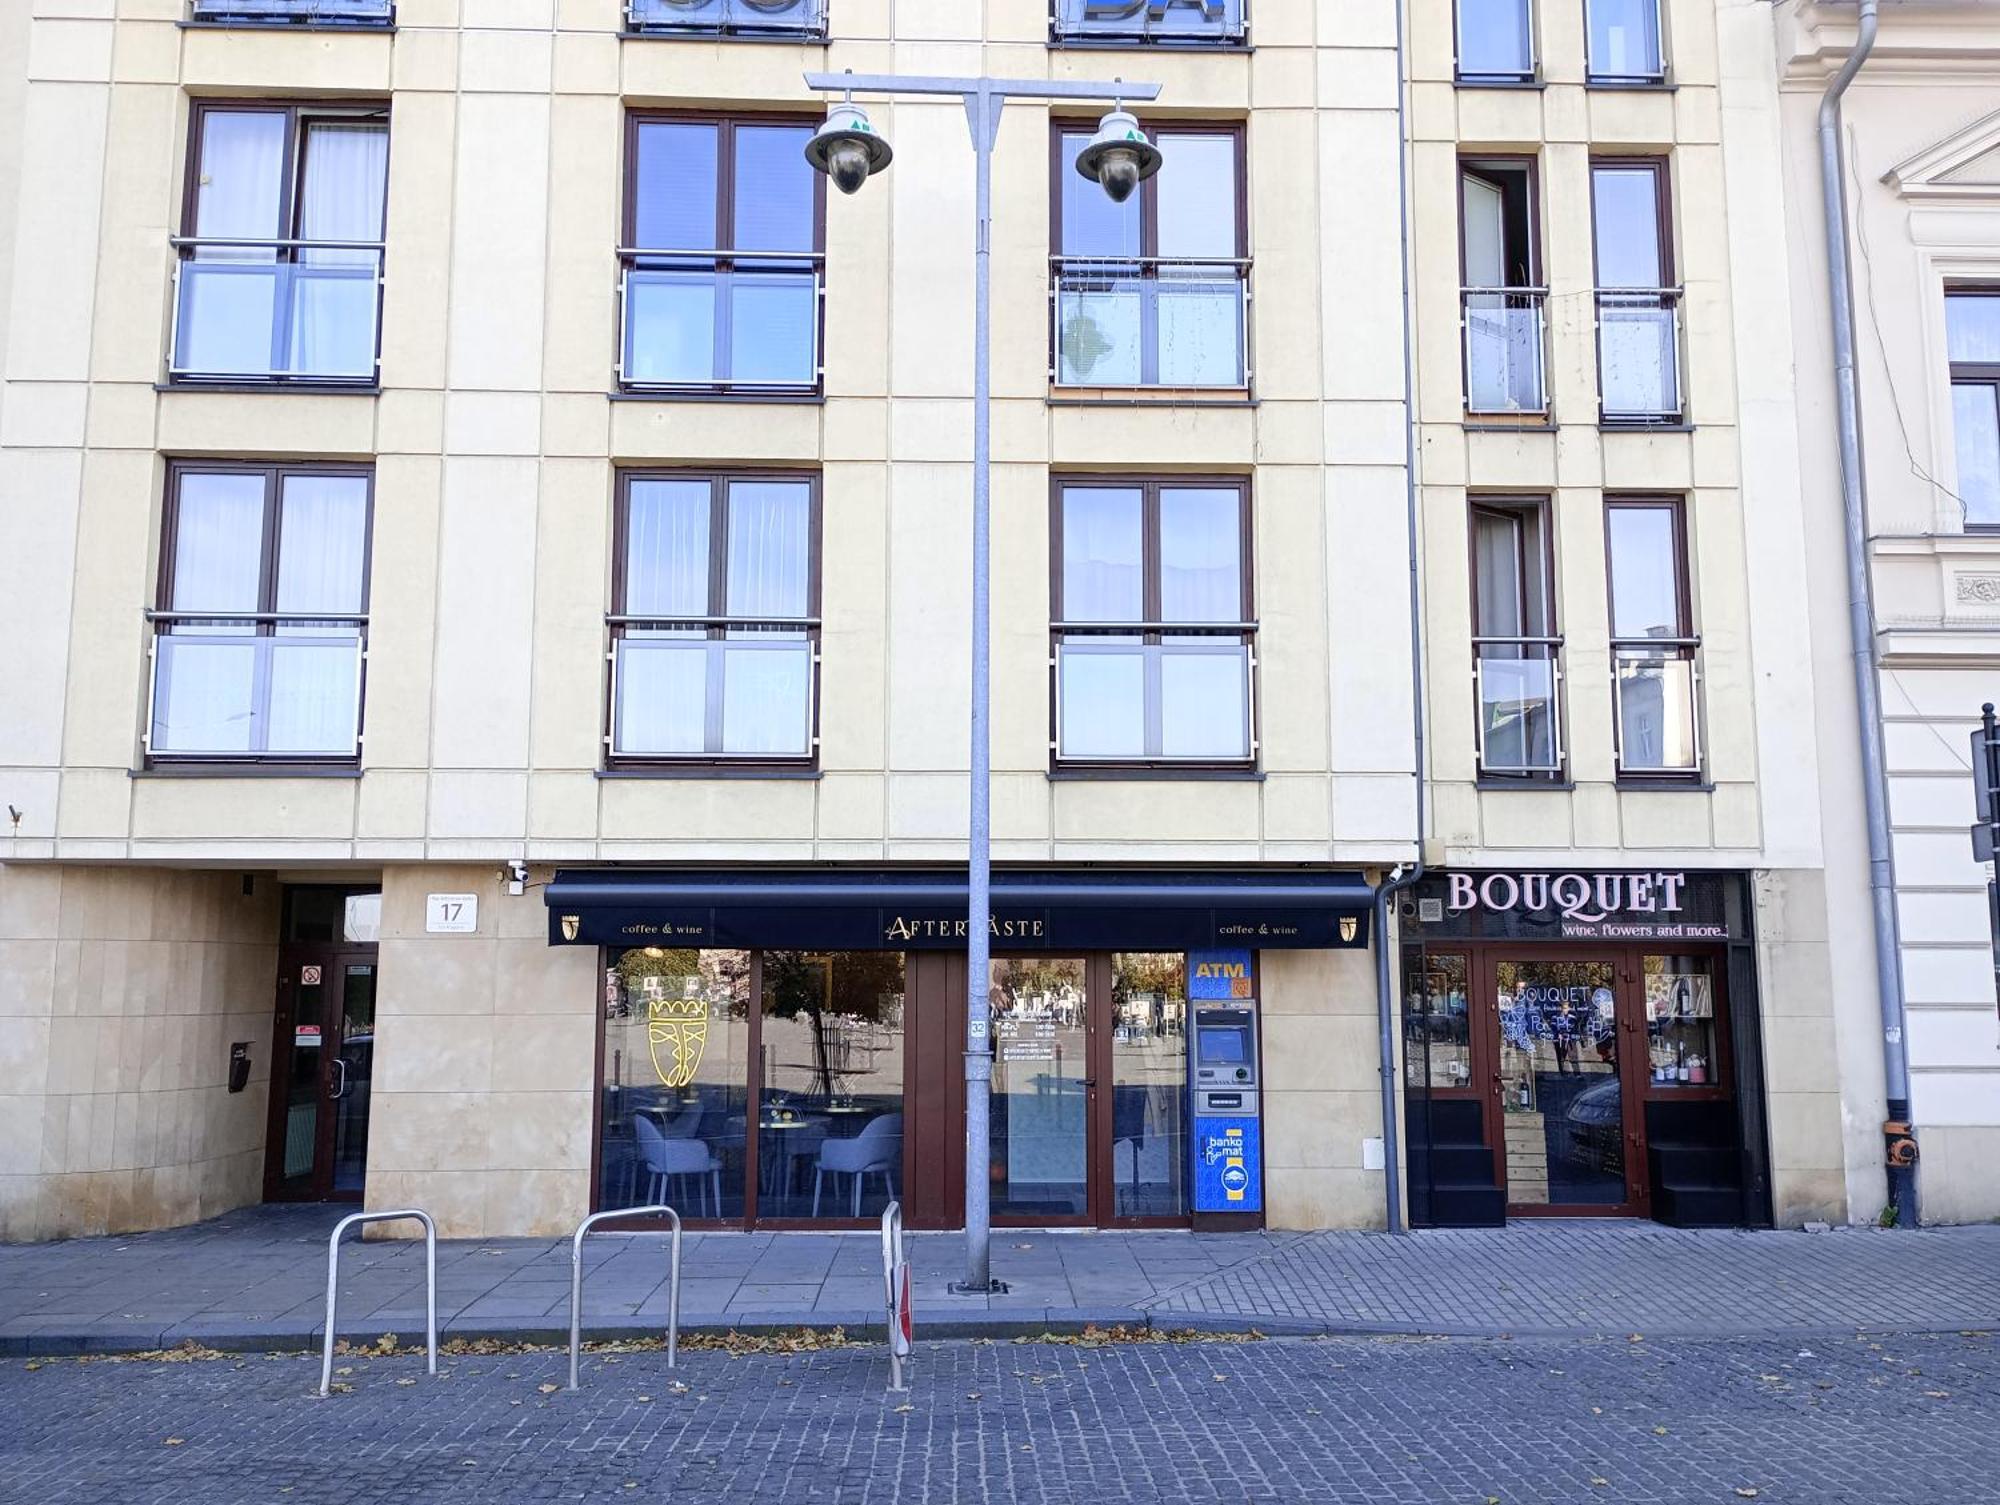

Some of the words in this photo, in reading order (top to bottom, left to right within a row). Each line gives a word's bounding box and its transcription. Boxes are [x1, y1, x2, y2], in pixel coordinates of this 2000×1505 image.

[1447, 872, 1685, 922] BOUQUET
[441, 903, 463, 922] 17
[621, 924, 658, 935] coffee
[662, 922, 674, 935] &
[676, 924, 703, 935] wine
[885, 914, 1044, 940] AFTERASTE
[1219, 924, 1254, 935] coffee
[1258, 922, 1269, 935] &
[1273, 924, 1298, 935] wine
[1563, 924, 1598, 937] wine,
[1602, 924, 1653, 937] flowers
[1657, 924, 1683, 937] and
[1195, 962, 1245, 978] ATM
[1515, 986, 1590, 1003] BOUQUET
[972, 1023, 985, 1033] 32
[1210, 1136, 1242, 1146] banko
[1222, 1147, 1243, 1156] mat
